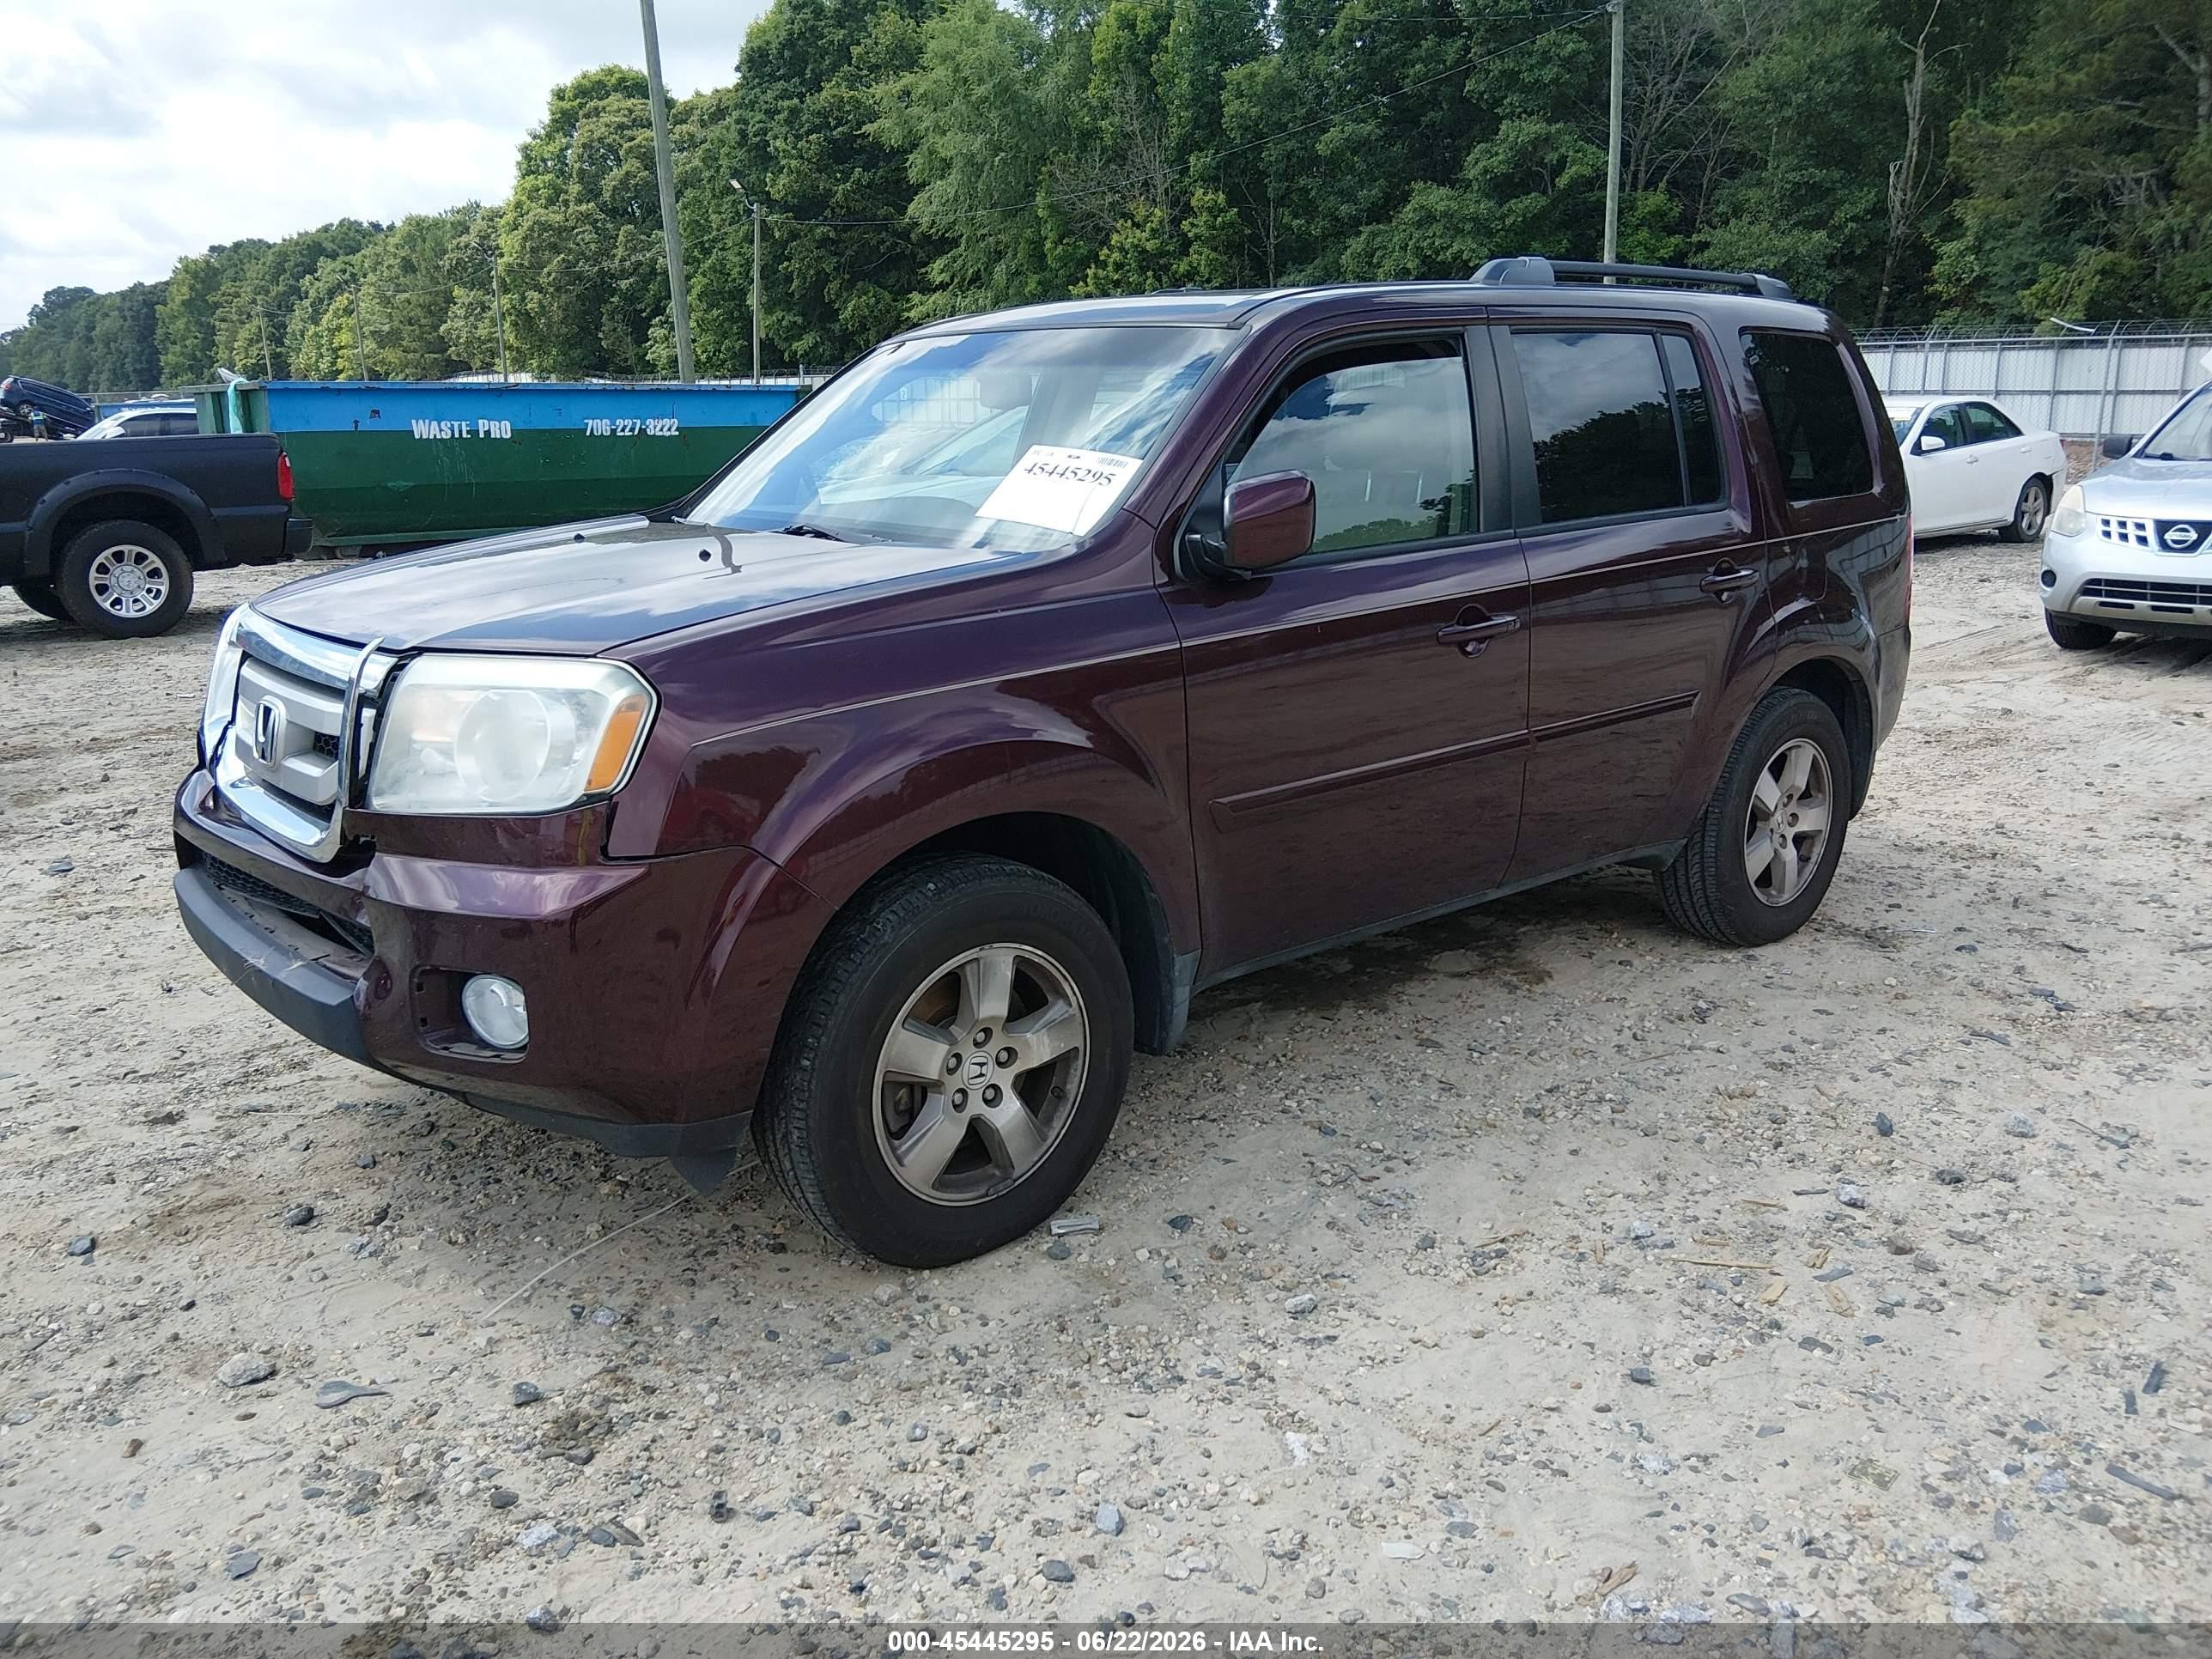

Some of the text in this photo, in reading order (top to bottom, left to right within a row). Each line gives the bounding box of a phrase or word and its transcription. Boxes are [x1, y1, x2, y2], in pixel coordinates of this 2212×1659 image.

[411, 419, 512, 439] WASTE PRO
[584, 418, 679, 436] 706-227-3222
[1024, 462, 1117, 487] 45445295
